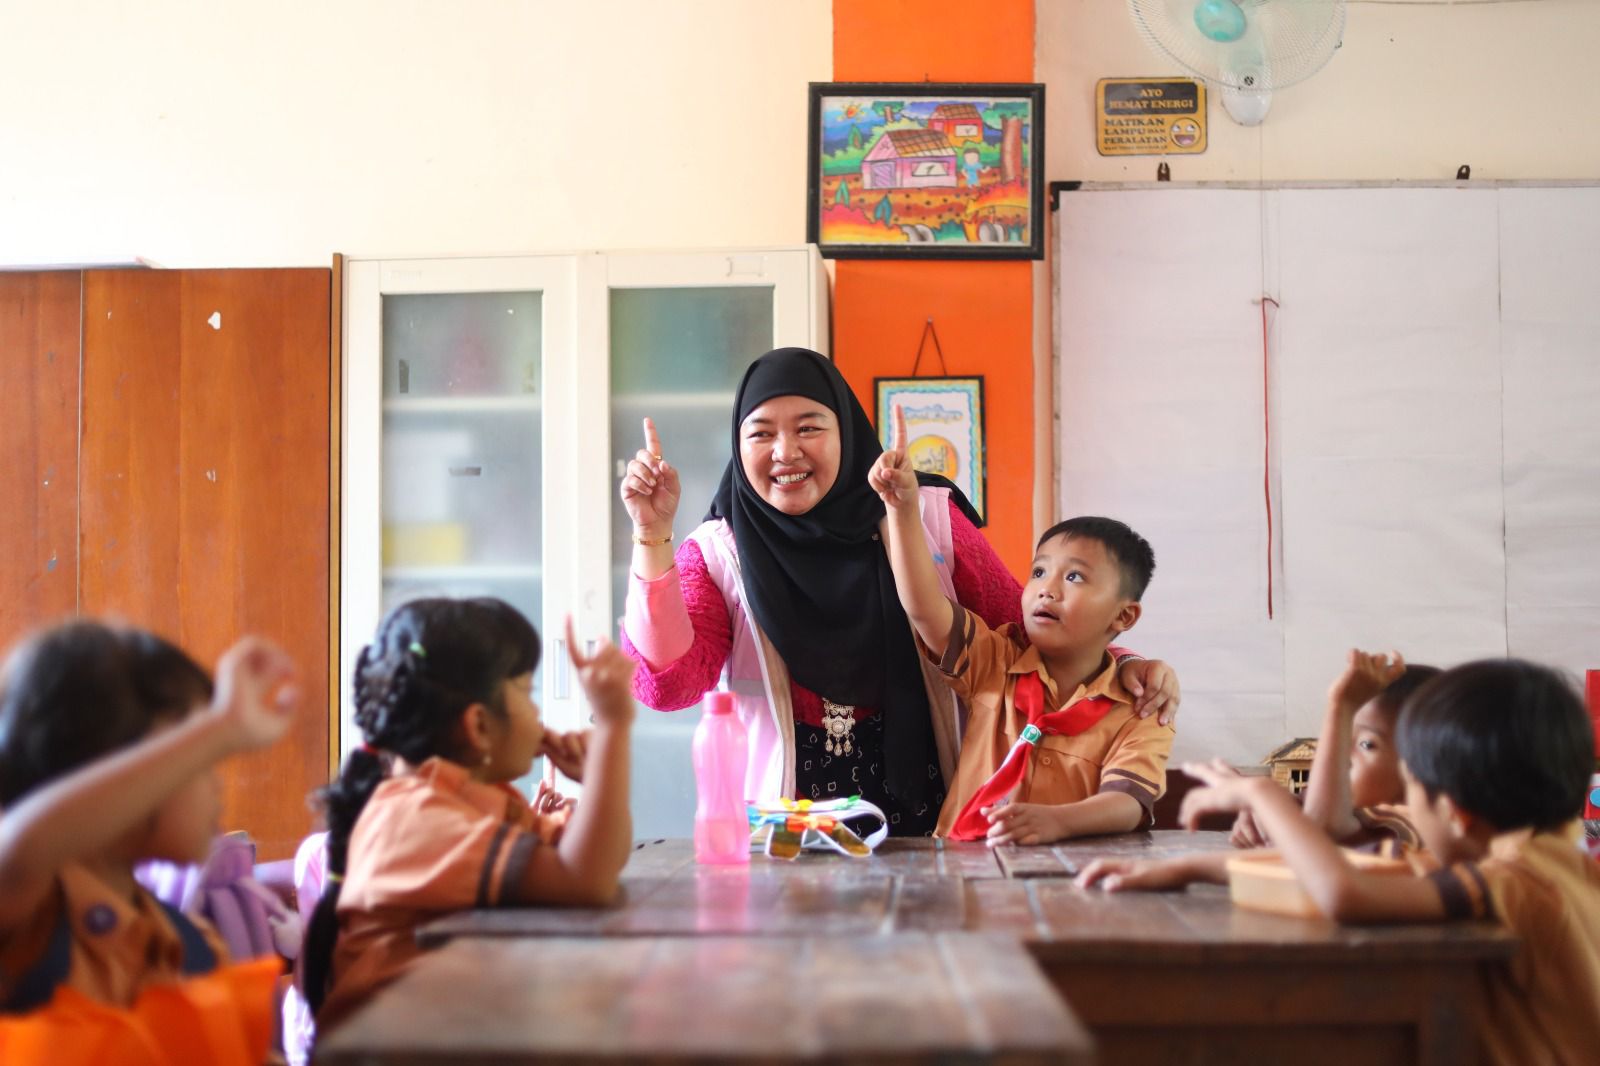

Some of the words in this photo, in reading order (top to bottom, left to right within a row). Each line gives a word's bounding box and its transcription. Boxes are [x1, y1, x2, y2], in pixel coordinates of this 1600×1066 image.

[1140, 88, 1163, 97] AYO
[1109, 100, 1148, 109] HEMAT
[1151, 100, 1193, 108] ENERGI
[1104, 118, 1164, 126] MATIKAN
[1104, 136, 1167, 144] PERALATAN
